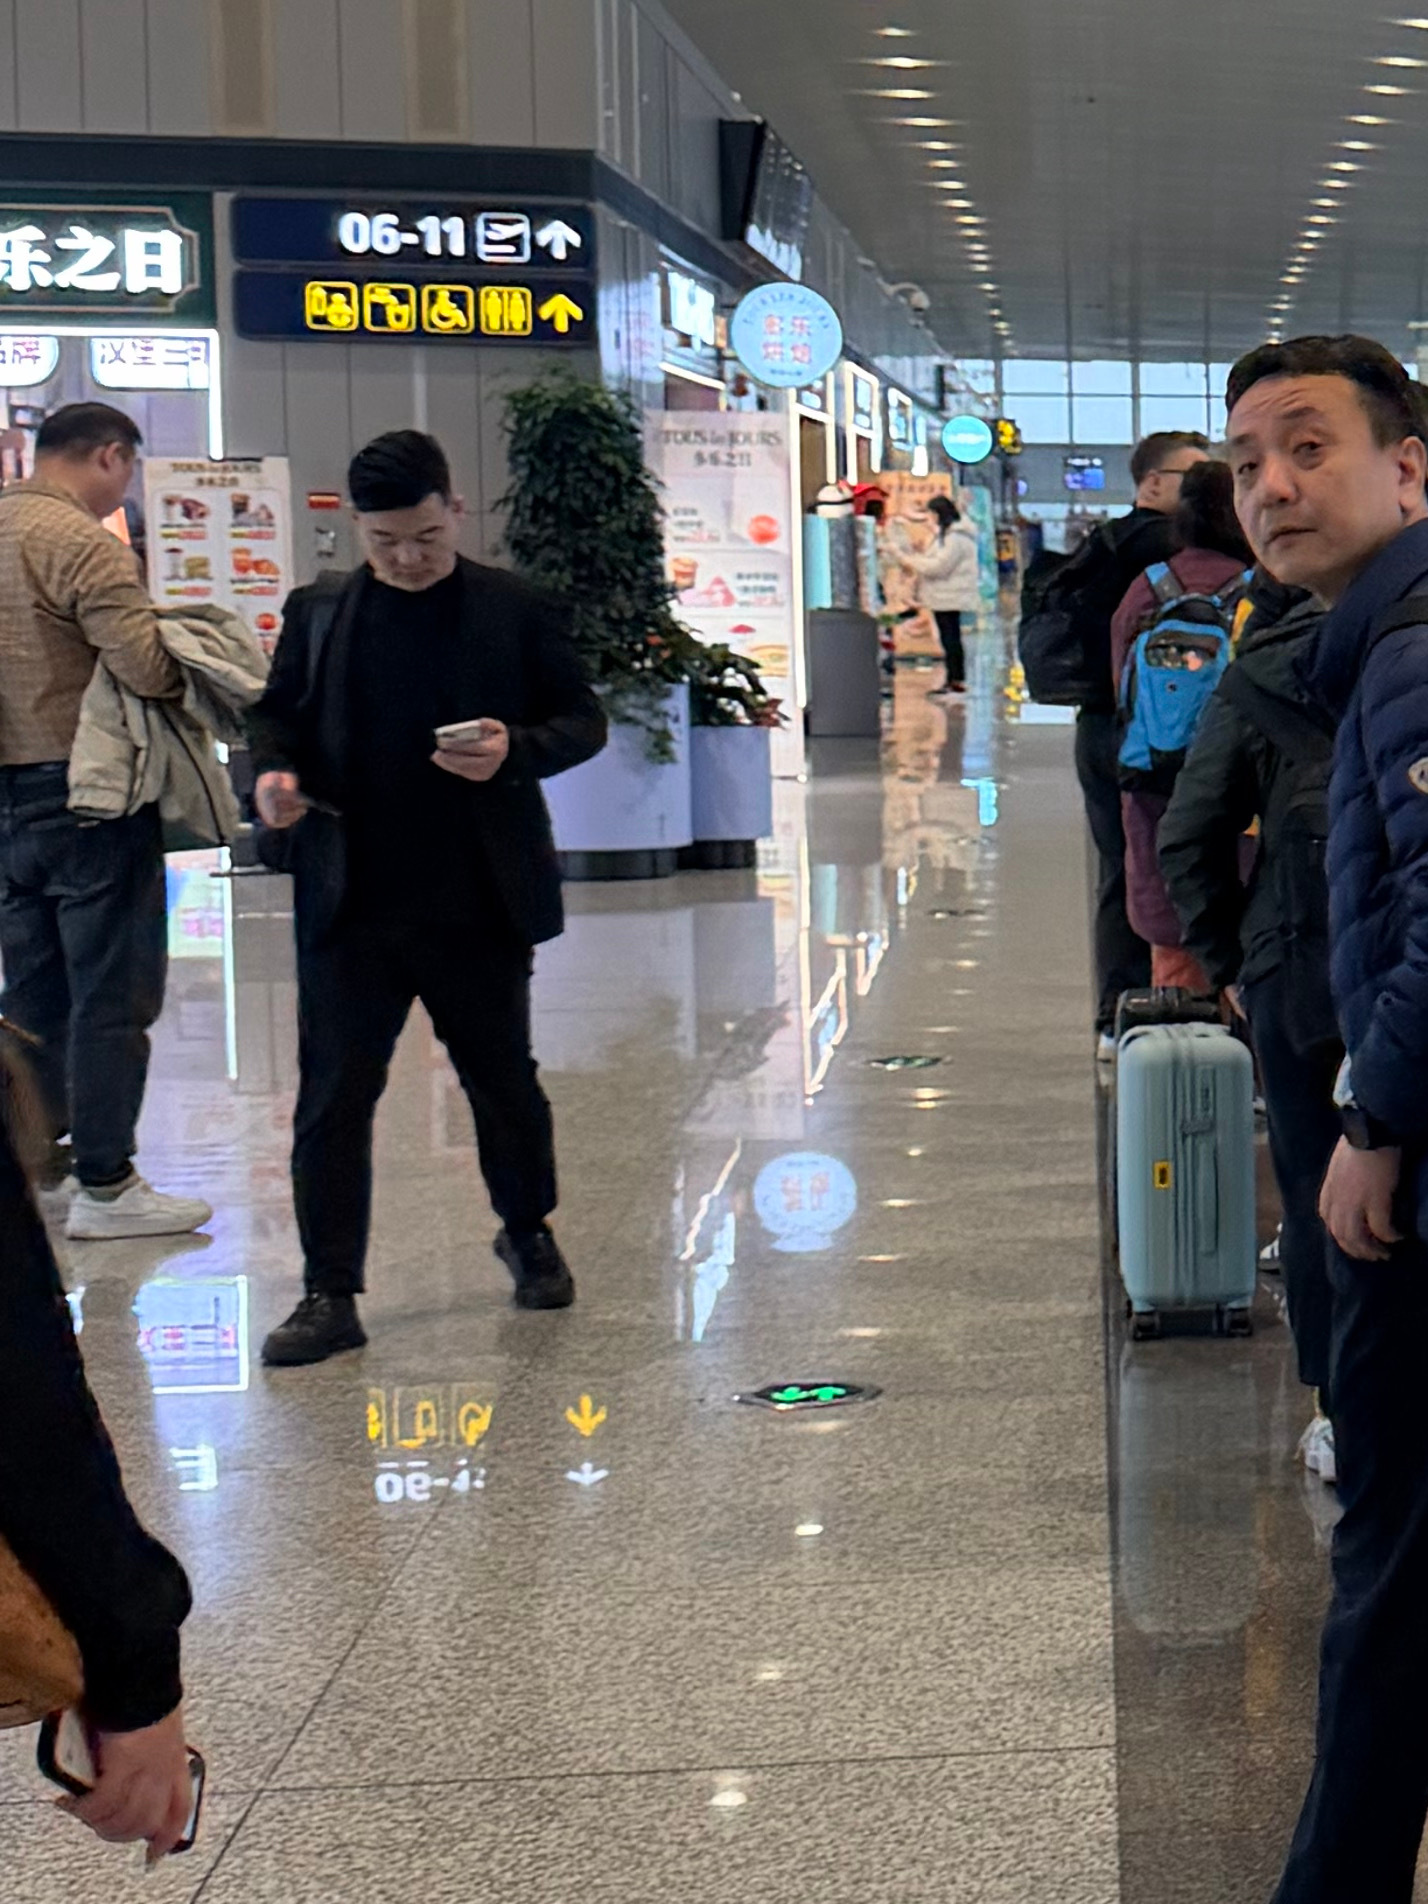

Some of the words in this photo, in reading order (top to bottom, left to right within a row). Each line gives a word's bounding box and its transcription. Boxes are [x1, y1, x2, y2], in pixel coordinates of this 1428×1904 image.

[0, 224, 183, 294] 乐之日
[338, 212, 466, 257] 06-11
